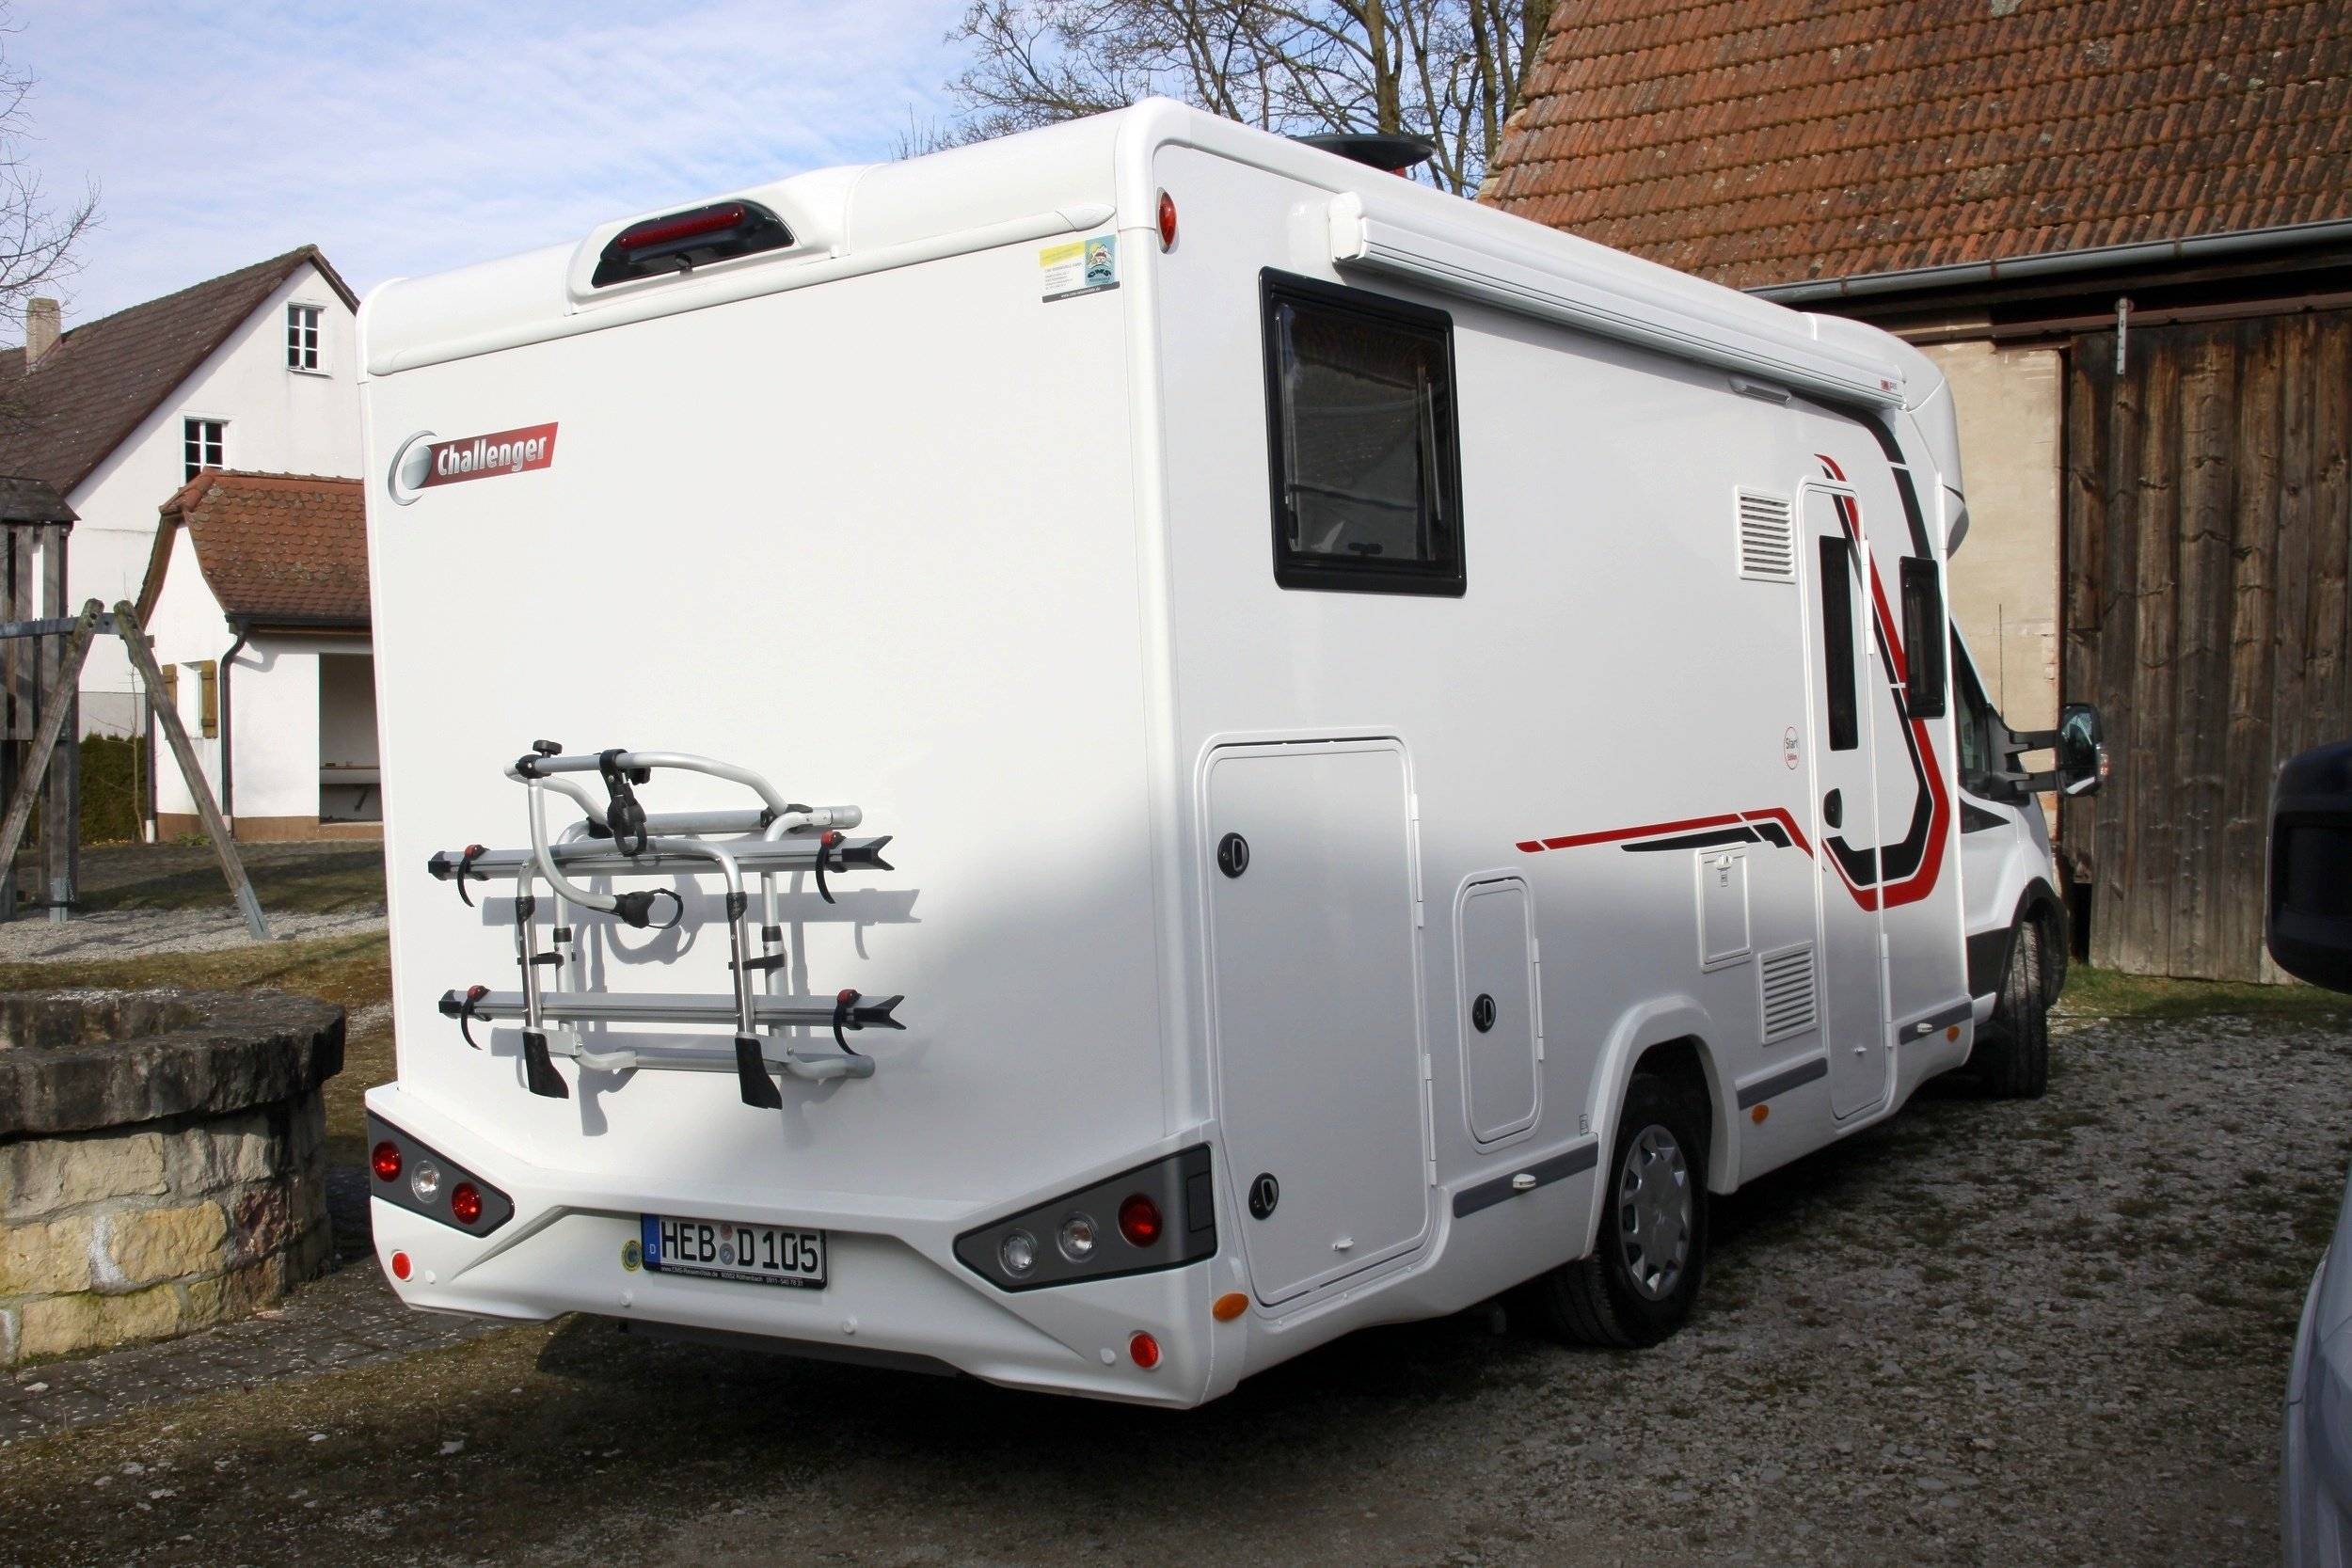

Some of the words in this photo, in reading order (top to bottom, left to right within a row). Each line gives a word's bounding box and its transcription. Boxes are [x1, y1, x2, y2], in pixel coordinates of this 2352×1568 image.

[437, 436, 548, 476] Challenger
[649, 1243, 657, 1255] D
[661, 1220, 716, 1262] HEB
[737, 1228, 755, 1266] D
[762, 1230, 818, 1273] 105
